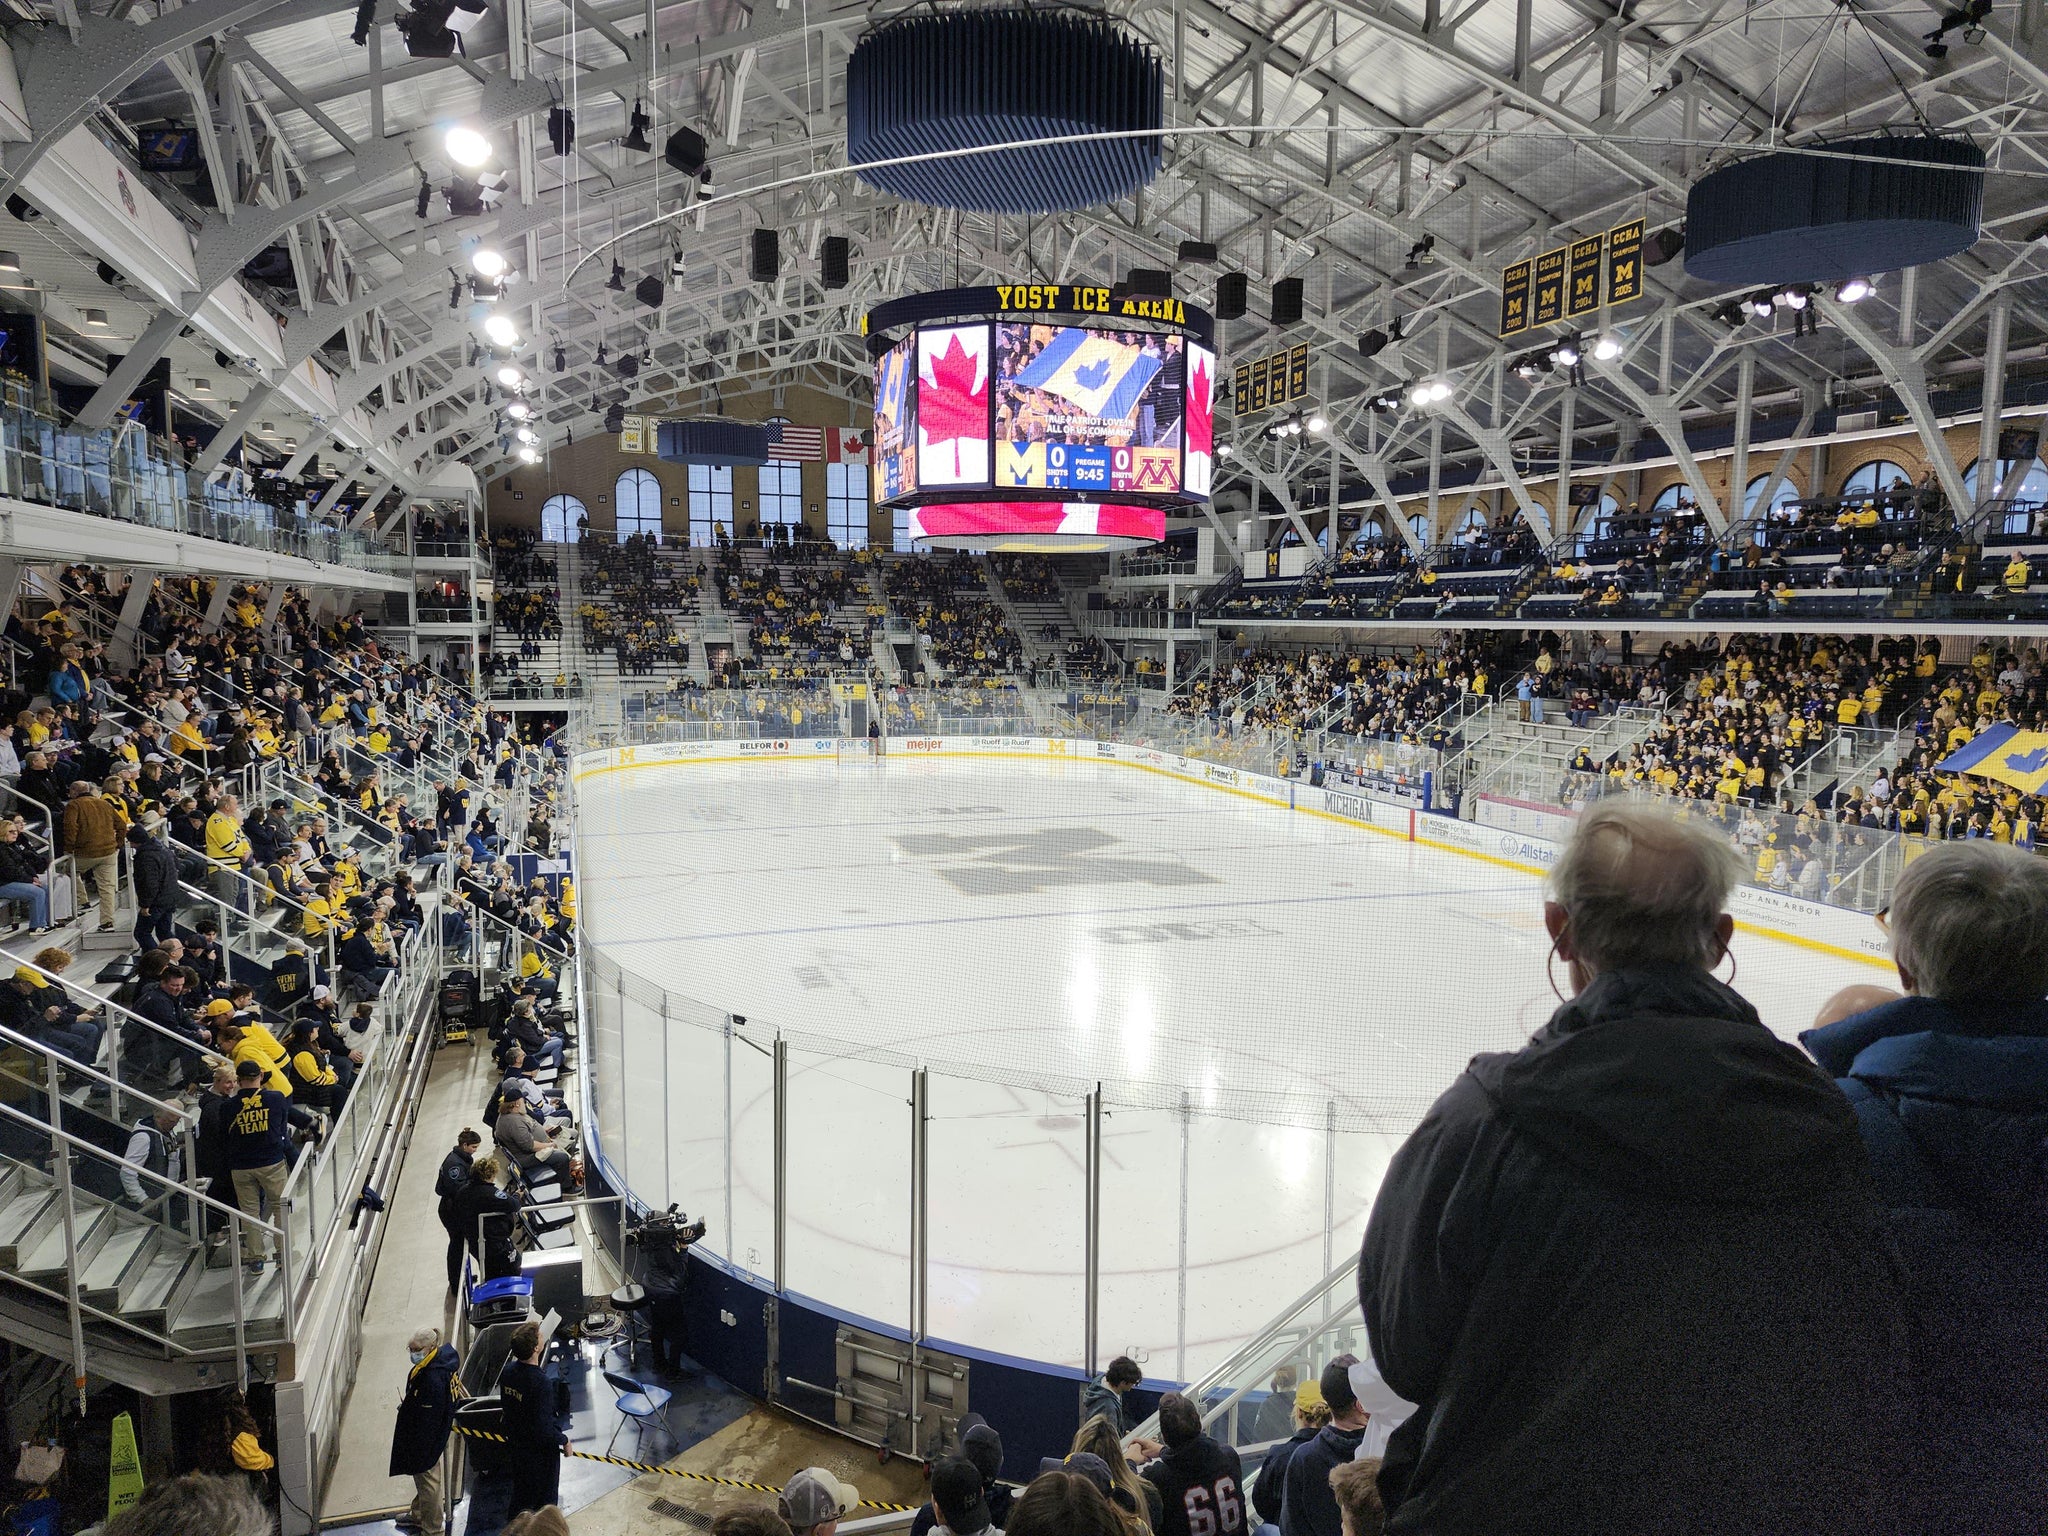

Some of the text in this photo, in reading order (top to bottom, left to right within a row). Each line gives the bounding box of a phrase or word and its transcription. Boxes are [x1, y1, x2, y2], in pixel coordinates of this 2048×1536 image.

[1613, 226, 1640, 245] CCHA
[1574, 242, 1599, 259] CCHA
[1612, 244, 1640, 259] CHAMPIONS
[1539, 255, 1562, 271] CCHA
[1506, 266, 1528, 282] CCHA
[1615, 260, 1634, 284] M
[1576, 274, 1594, 296] M
[1614, 282, 1633, 298] 2005
[1541, 286, 1557, 306] M
[997, 286, 1186, 325] YOST ICE ARENA
[1507, 296, 1523, 316] M
[1045, 415, 1066, 424] TRUE
[1066, 416, 1101, 426] PATRIOT
[1103, 417, 1123, 426] LOVE
[1047, 425, 1133, 437] ALL OF US COMMAND
[1051, 446, 1065, 467] 0
[1115, 450, 1130, 470] 0
[1053, 477, 1060, 485] 0
[1076, 468, 1104, 480] 9:45
[1118, 480, 1125, 488] 0
[907, 738, 943, 752] meijer
[1048, 739, 1066, 753] M
[619, 746, 636, 763] M
[1324, 791, 1373, 823] MICHIGAN
[1519, 843, 1560, 865] Allstate
[1740, 891, 1821, 917] OF ANN ARBOR
[277, 974, 296, 984] EVENT
[280, 983, 296, 992] TEAM
[236, 1108, 270, 1125] EVENT
[239, 1119, 269, 1135] TEAM
[115, 1498, 135, 1506] FLOO
[1184, 1476, 1240, 1536] 66
